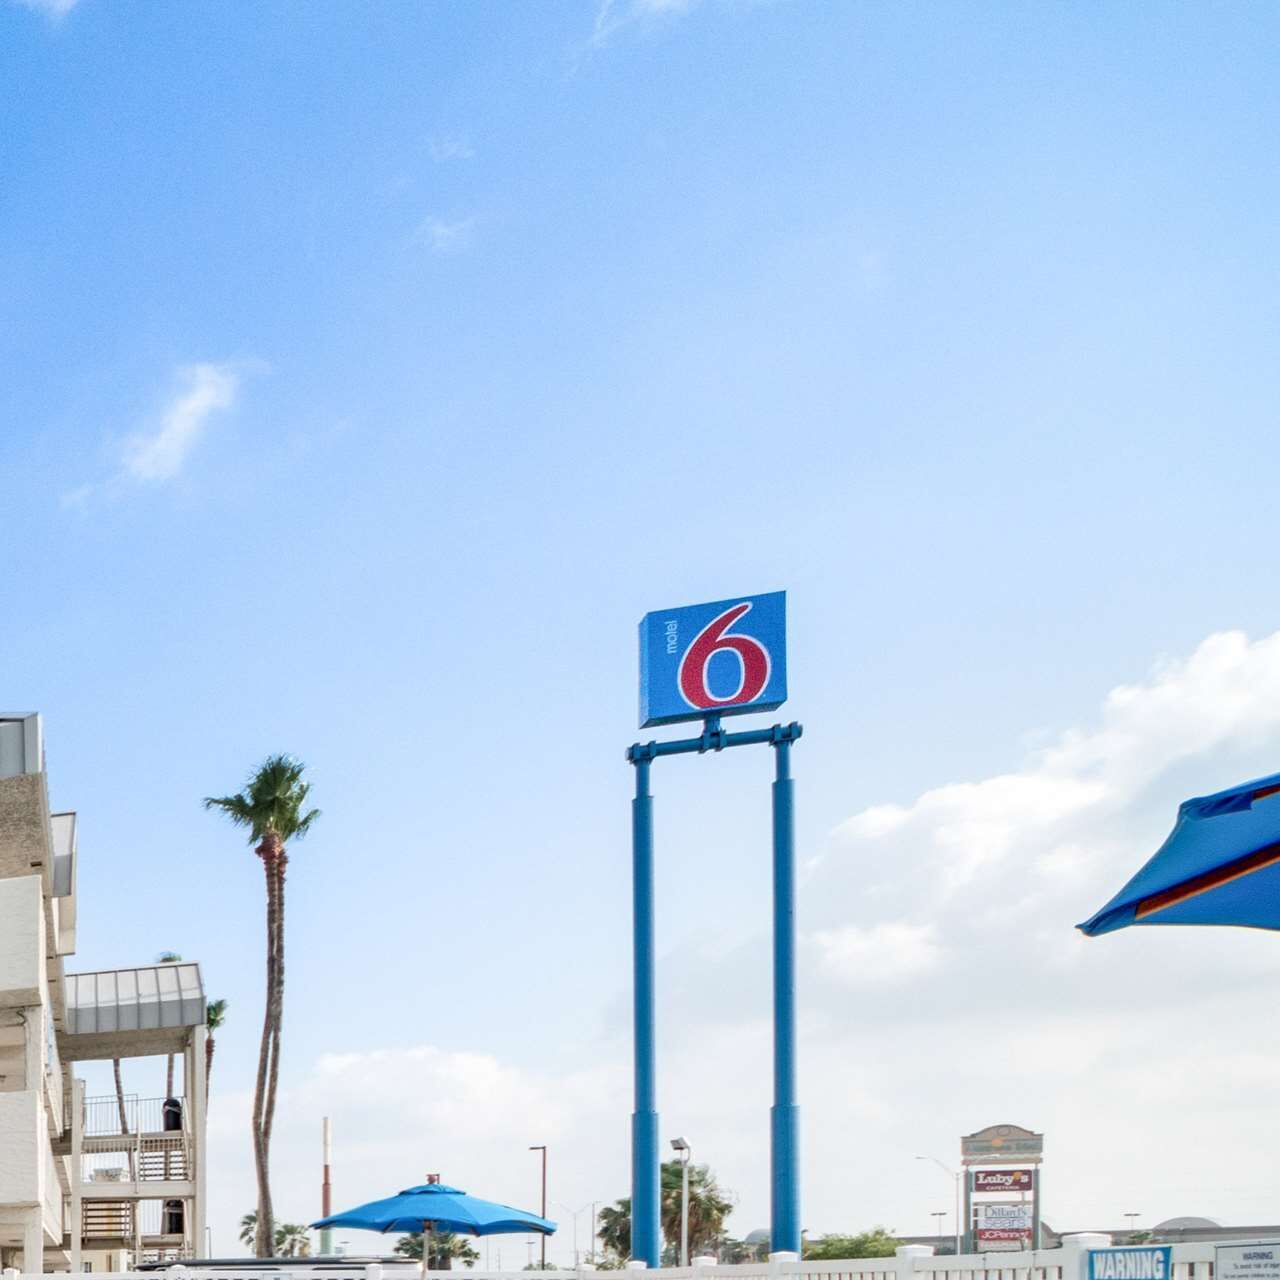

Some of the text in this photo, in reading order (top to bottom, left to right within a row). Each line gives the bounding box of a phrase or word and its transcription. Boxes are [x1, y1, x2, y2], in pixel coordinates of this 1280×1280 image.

[664, 620, 679, 654] motel
[677, 601, 772, 710] 6
[976, 1171, 1029, 1186] Luby's
